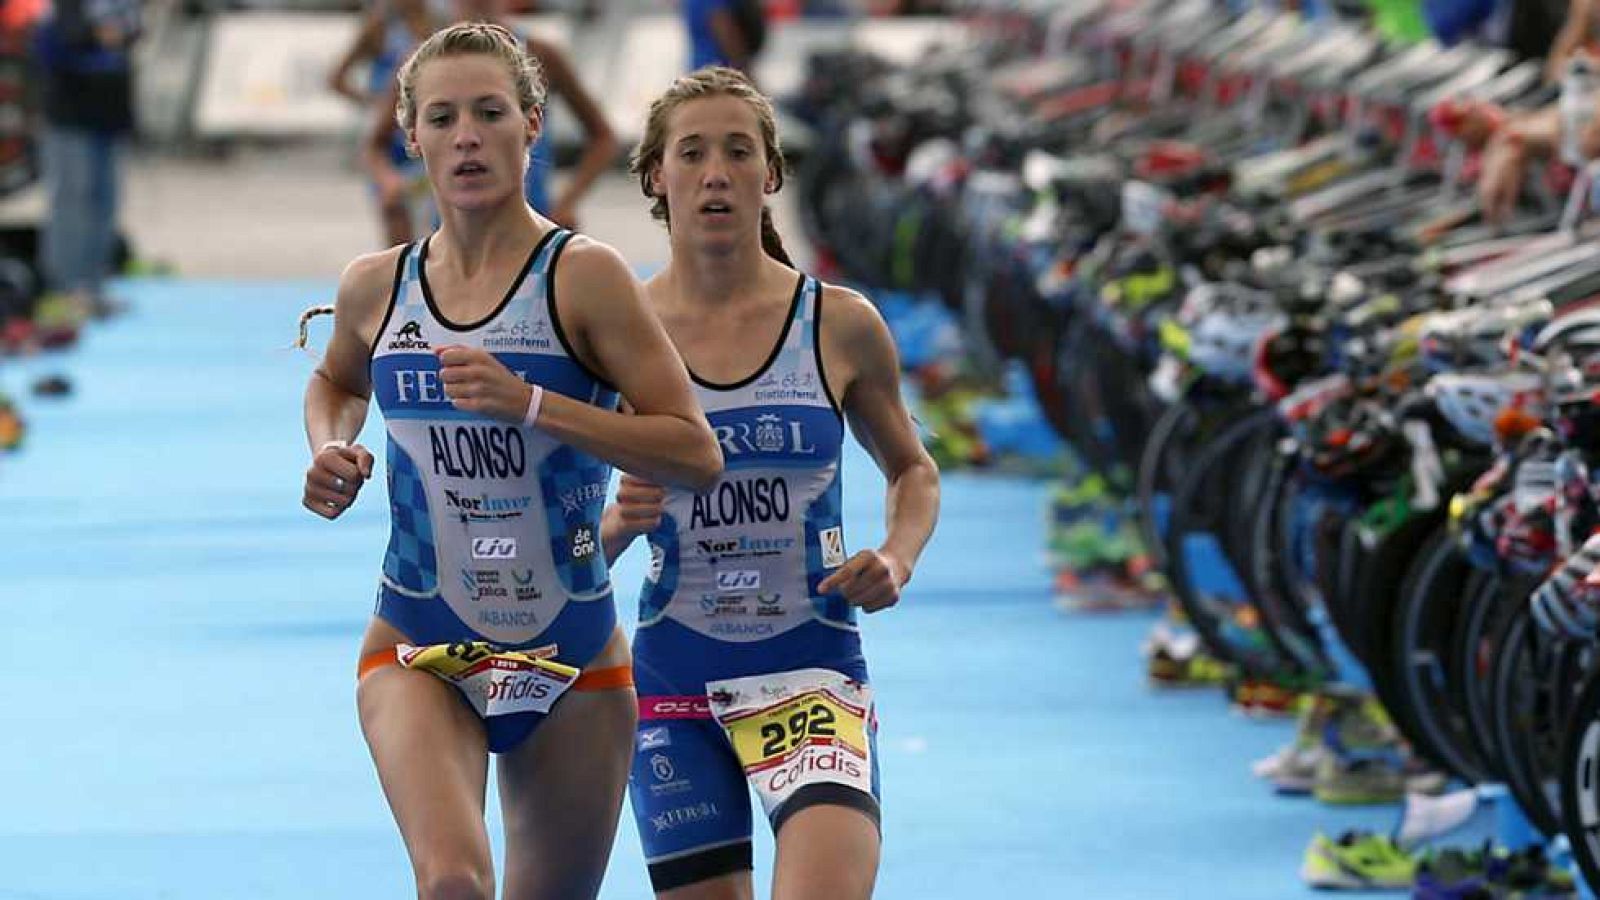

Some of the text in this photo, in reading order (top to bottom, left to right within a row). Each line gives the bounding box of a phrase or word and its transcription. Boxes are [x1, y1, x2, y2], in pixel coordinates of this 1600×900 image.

[429, 425, 525, 479] ALONSO
[690, 477, 789, 530] ALONSO
[487, 675, 551, 701] ofidis
[760, 703, 836, 757] 292
[769, 751, 861, 792] Cofidis
